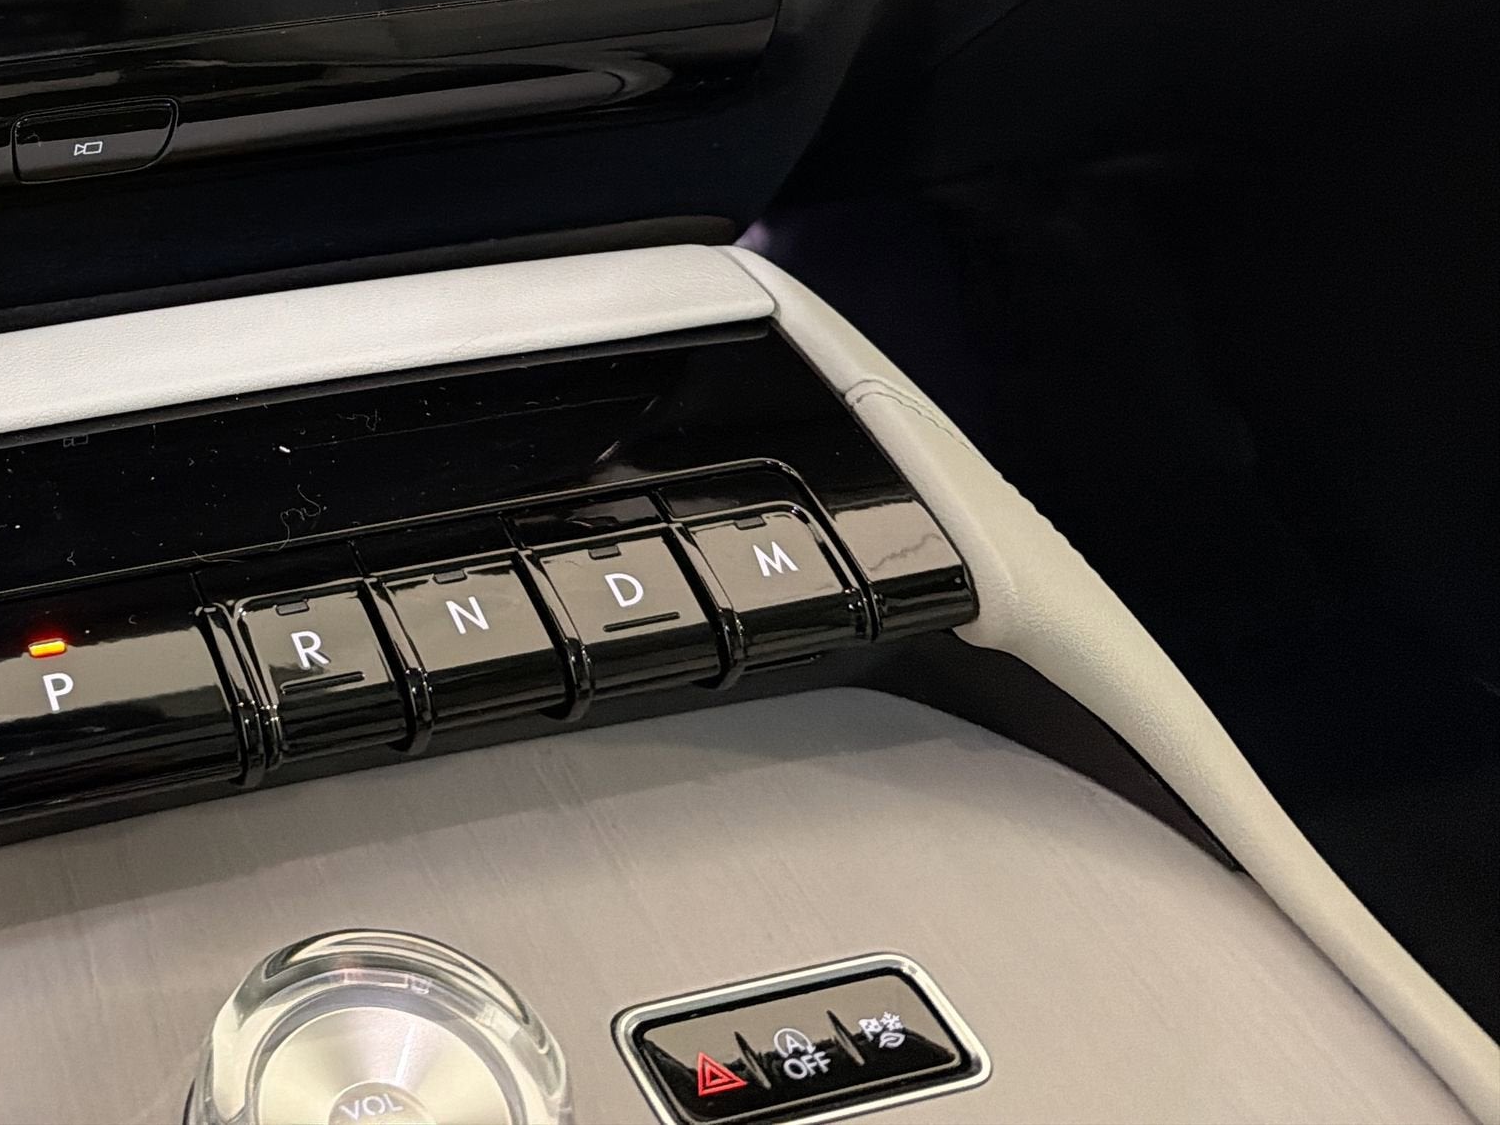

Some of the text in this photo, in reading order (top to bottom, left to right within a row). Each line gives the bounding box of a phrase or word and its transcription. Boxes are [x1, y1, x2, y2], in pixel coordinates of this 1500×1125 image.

[752, 540, 799, 578] M
[605, 572, 645, 609] D
[445, 596, 490, 635] N
[290, 630, 332, 671] R
[42, 672, 75, 712] P
[783, 1050, 832, 1080] OFF
[338, 1092, 405, 1122] VOL
